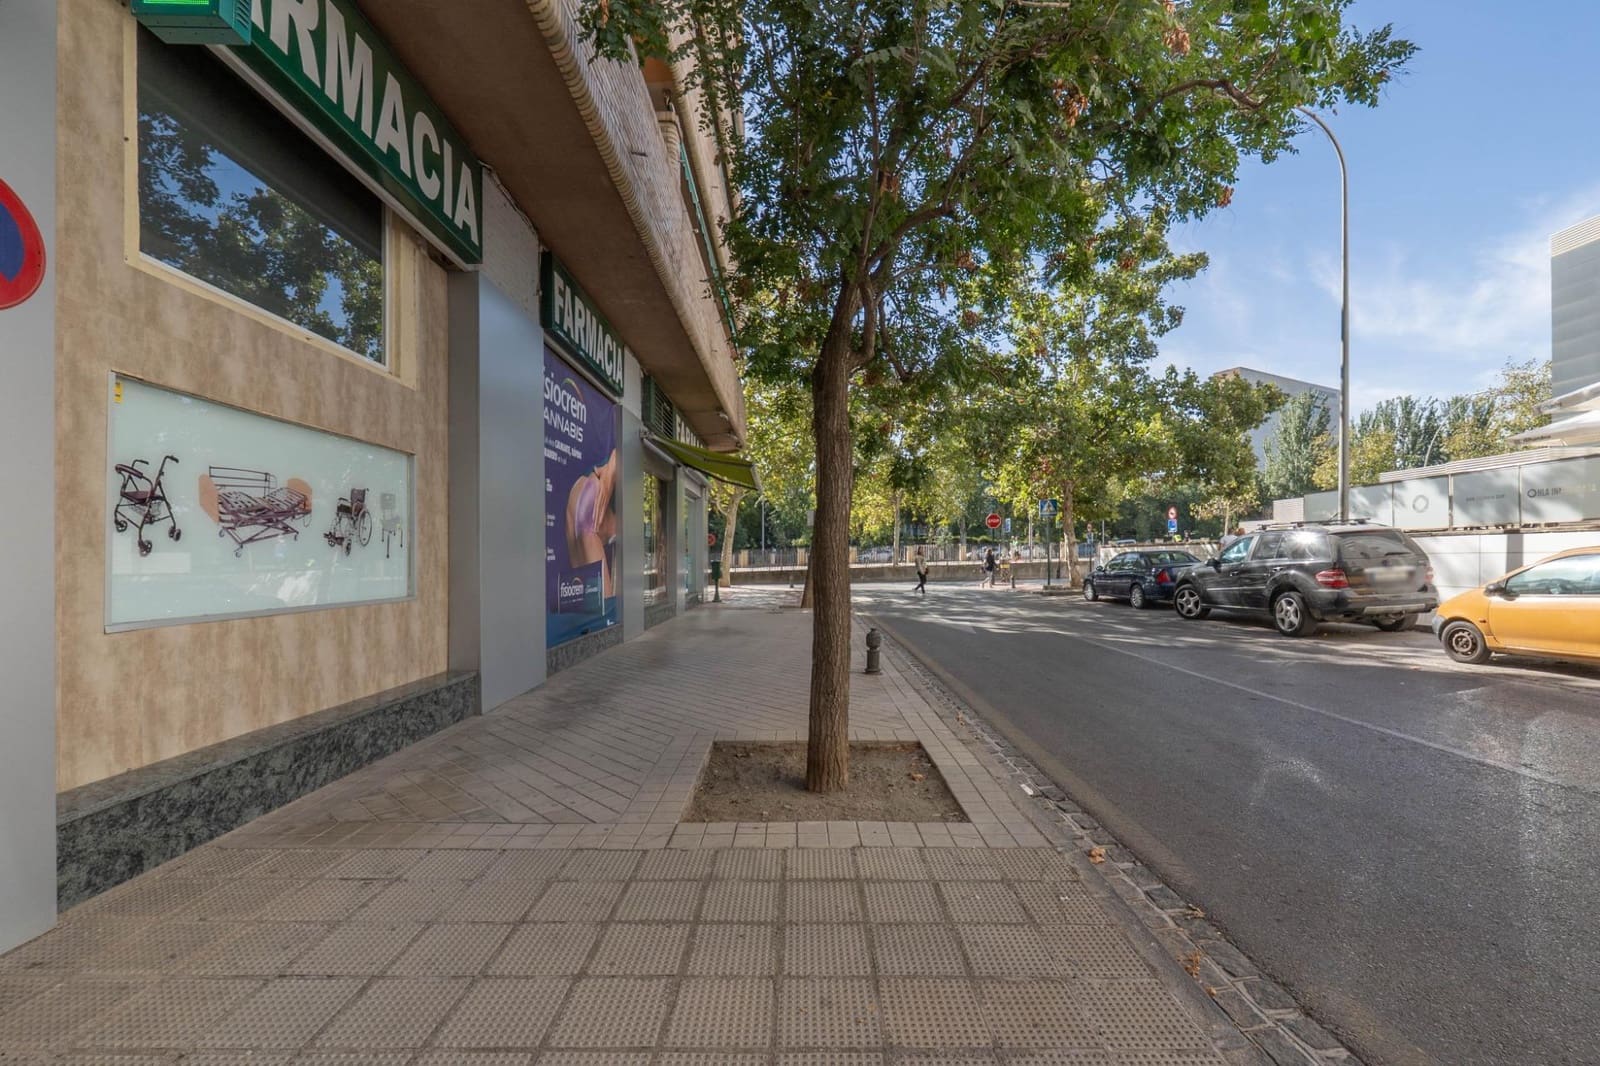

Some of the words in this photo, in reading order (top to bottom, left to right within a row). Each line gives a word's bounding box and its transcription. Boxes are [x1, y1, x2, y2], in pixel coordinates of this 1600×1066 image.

[553, 270, 623, 388] FARMACIA
[544, 372, 587, 425] siocrem
[544, 406, 583, 443] ANNABIS
